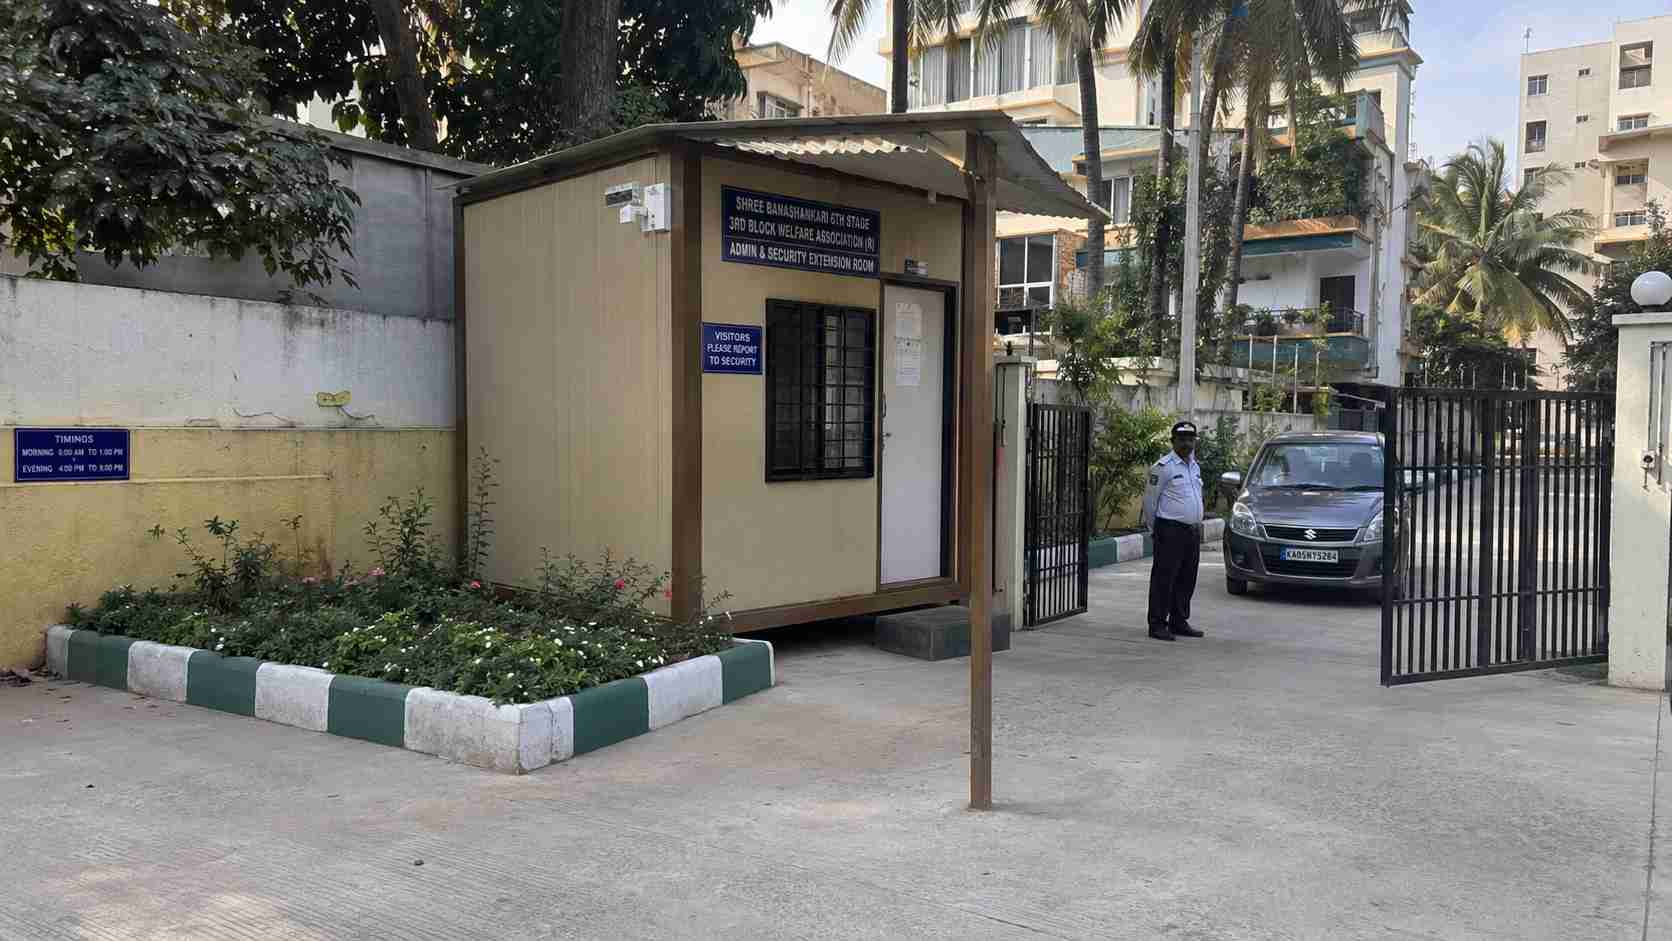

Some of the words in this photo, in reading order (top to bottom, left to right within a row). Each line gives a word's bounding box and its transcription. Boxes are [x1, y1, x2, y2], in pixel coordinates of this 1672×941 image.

[736, 196, 765, 214] SHREE
[766, 201, 829, 225] BANASHANKARI
[831, 212, 845, 226] 6TH
[729, 216, 746, 232] 3RD
[748, 219, 776, 236] BLOCK
[777, 223, 815, 241] WELFARE
[815, 229, 864, 249] ASSOCIATION
[864, 236, 875, 252] (R)
[729, 242, 758, 257] ADMIN
[759, 245, 766, 259] &
[767, 246, 807, 265] SECURITY
[809, 252, 852, 270] EXTENSION
[852, 257, 874, 272] ROOM
[714, 331, 752, 342] VISITORS
[706, 343, 732, 353] PLEASE
[733, 344, 758, 354] REPORT
[709, 355, 720, 366] TO
[721, 356, 757, 367] SECURITY
[22, 448, 54, 456] MORNING
[74, 448, 84, 456] AM
[88, 448, 97, 456] TO
[113, 448, 124, 456] PM
[22, 464, 53, 473] EVENING
[73, 464, 84, 472] PM
[88, 464, 97, 472] TO
[113, 463, 124, 472] PM
